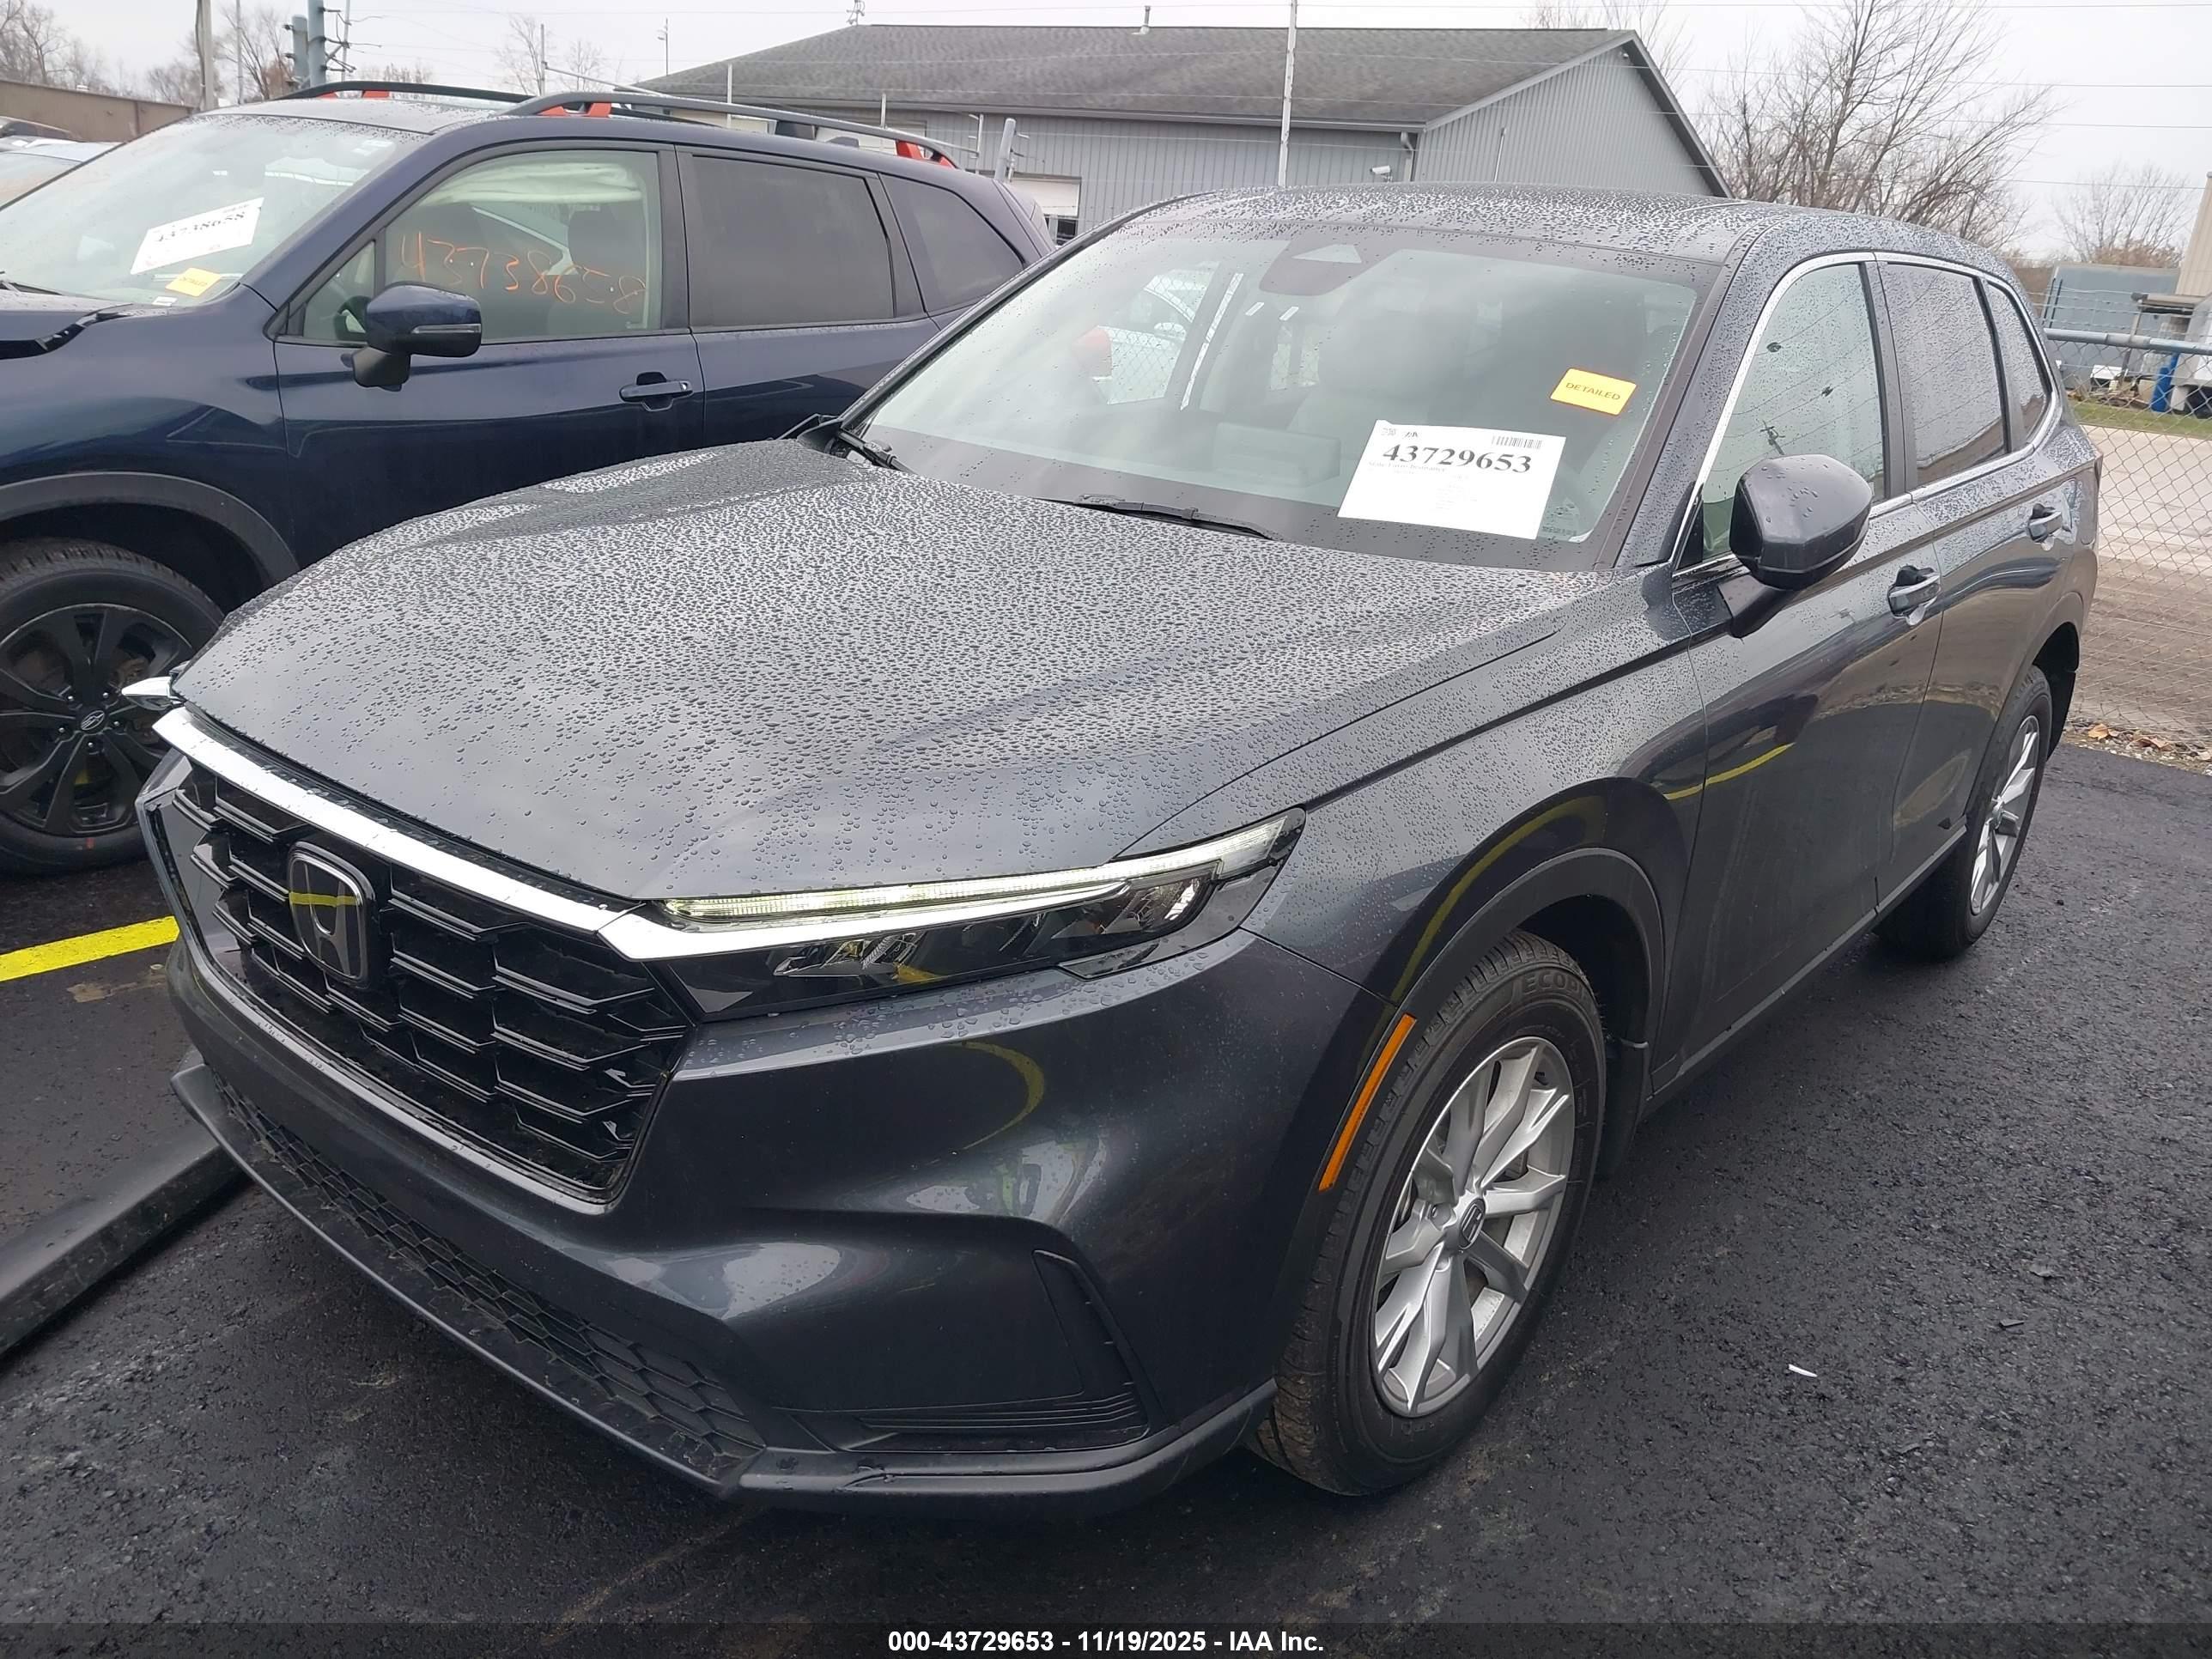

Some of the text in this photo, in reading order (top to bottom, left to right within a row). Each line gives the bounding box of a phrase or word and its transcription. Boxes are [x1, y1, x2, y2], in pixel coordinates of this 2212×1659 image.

[401, 231, 646, 314] 43738658
[1565, 382, 1620, 400] DETAILED
[1382, 444, 1532, 473] 43729653
